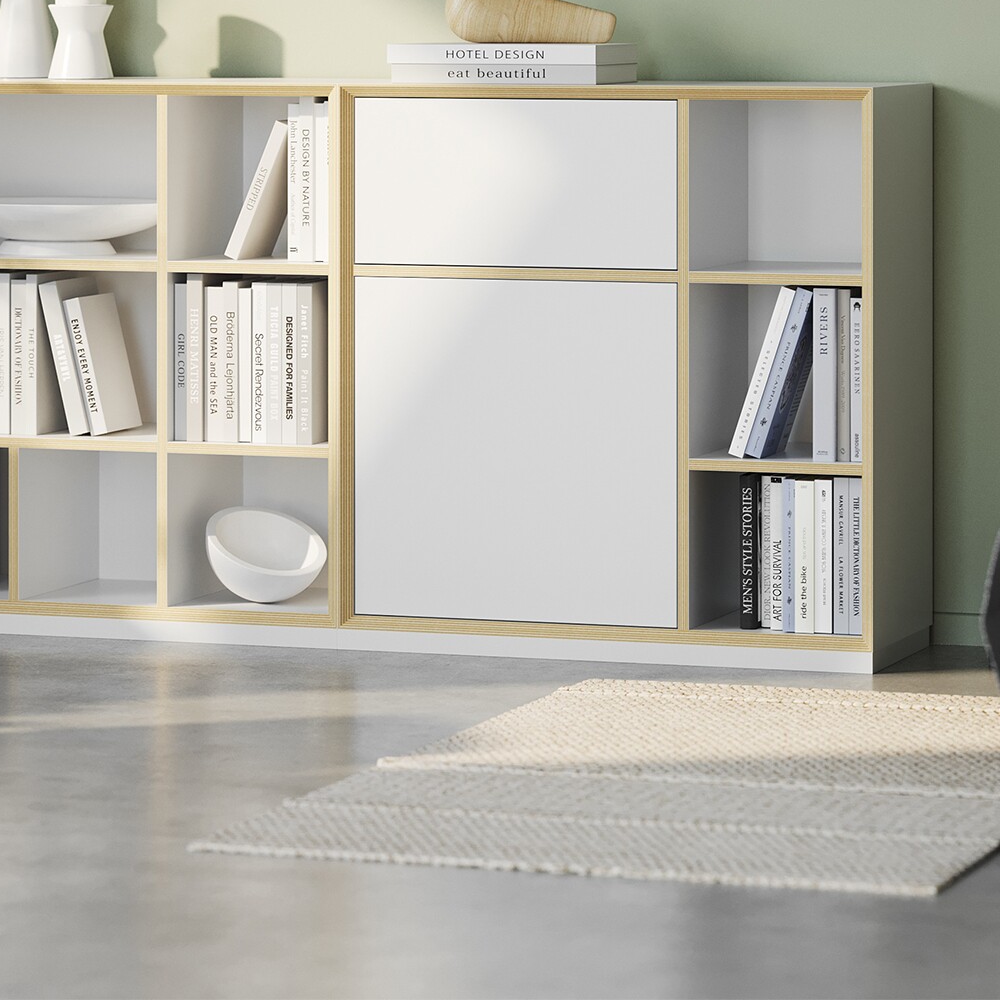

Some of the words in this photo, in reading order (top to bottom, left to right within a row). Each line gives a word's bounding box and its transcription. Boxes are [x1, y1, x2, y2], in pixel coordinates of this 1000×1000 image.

[445, 49, 489, 60] HOTEL
[495, 49, 545, 60] DESIGN
[447, 69, 470, 79] eat
[477, 68, 547, 79] beautiful
[302, 129, 310, 167] DESIGN
[302, 170, 310, 182] BY
[246, 167, 268, 211] STRIPPED
[302, 186, 310, 227] NATURE
[210, 315, 218, 334] OLD
[820, 306, 828, 355] RIVERS
[210, 337, 218, 359] MAN
[254, 333, 264, 366] Secret
[70, 319, 83, 345] ENJOY
[77, 348, 90, 375] EVERY
[84, 377, 98, 414] MOMENT
[210, 362, 218, 379] and
[210, 380, 218, 396] the
[210, 399, 218, 415] SEA
[254, 368, 264, 432] Rendezvous
[742, 487, 753, 536] STORIES
[742, 538, 753, 576] STYLE
[773, 540, 782, 581] SURVIVAL
[838, 556, 844, 564] LA
[773, 583, 782, 600] FOR
[853, 576, 860, 586] OF
[742, 578, 753, 614] MEN'S
[773, 606, 782, 622] ART
